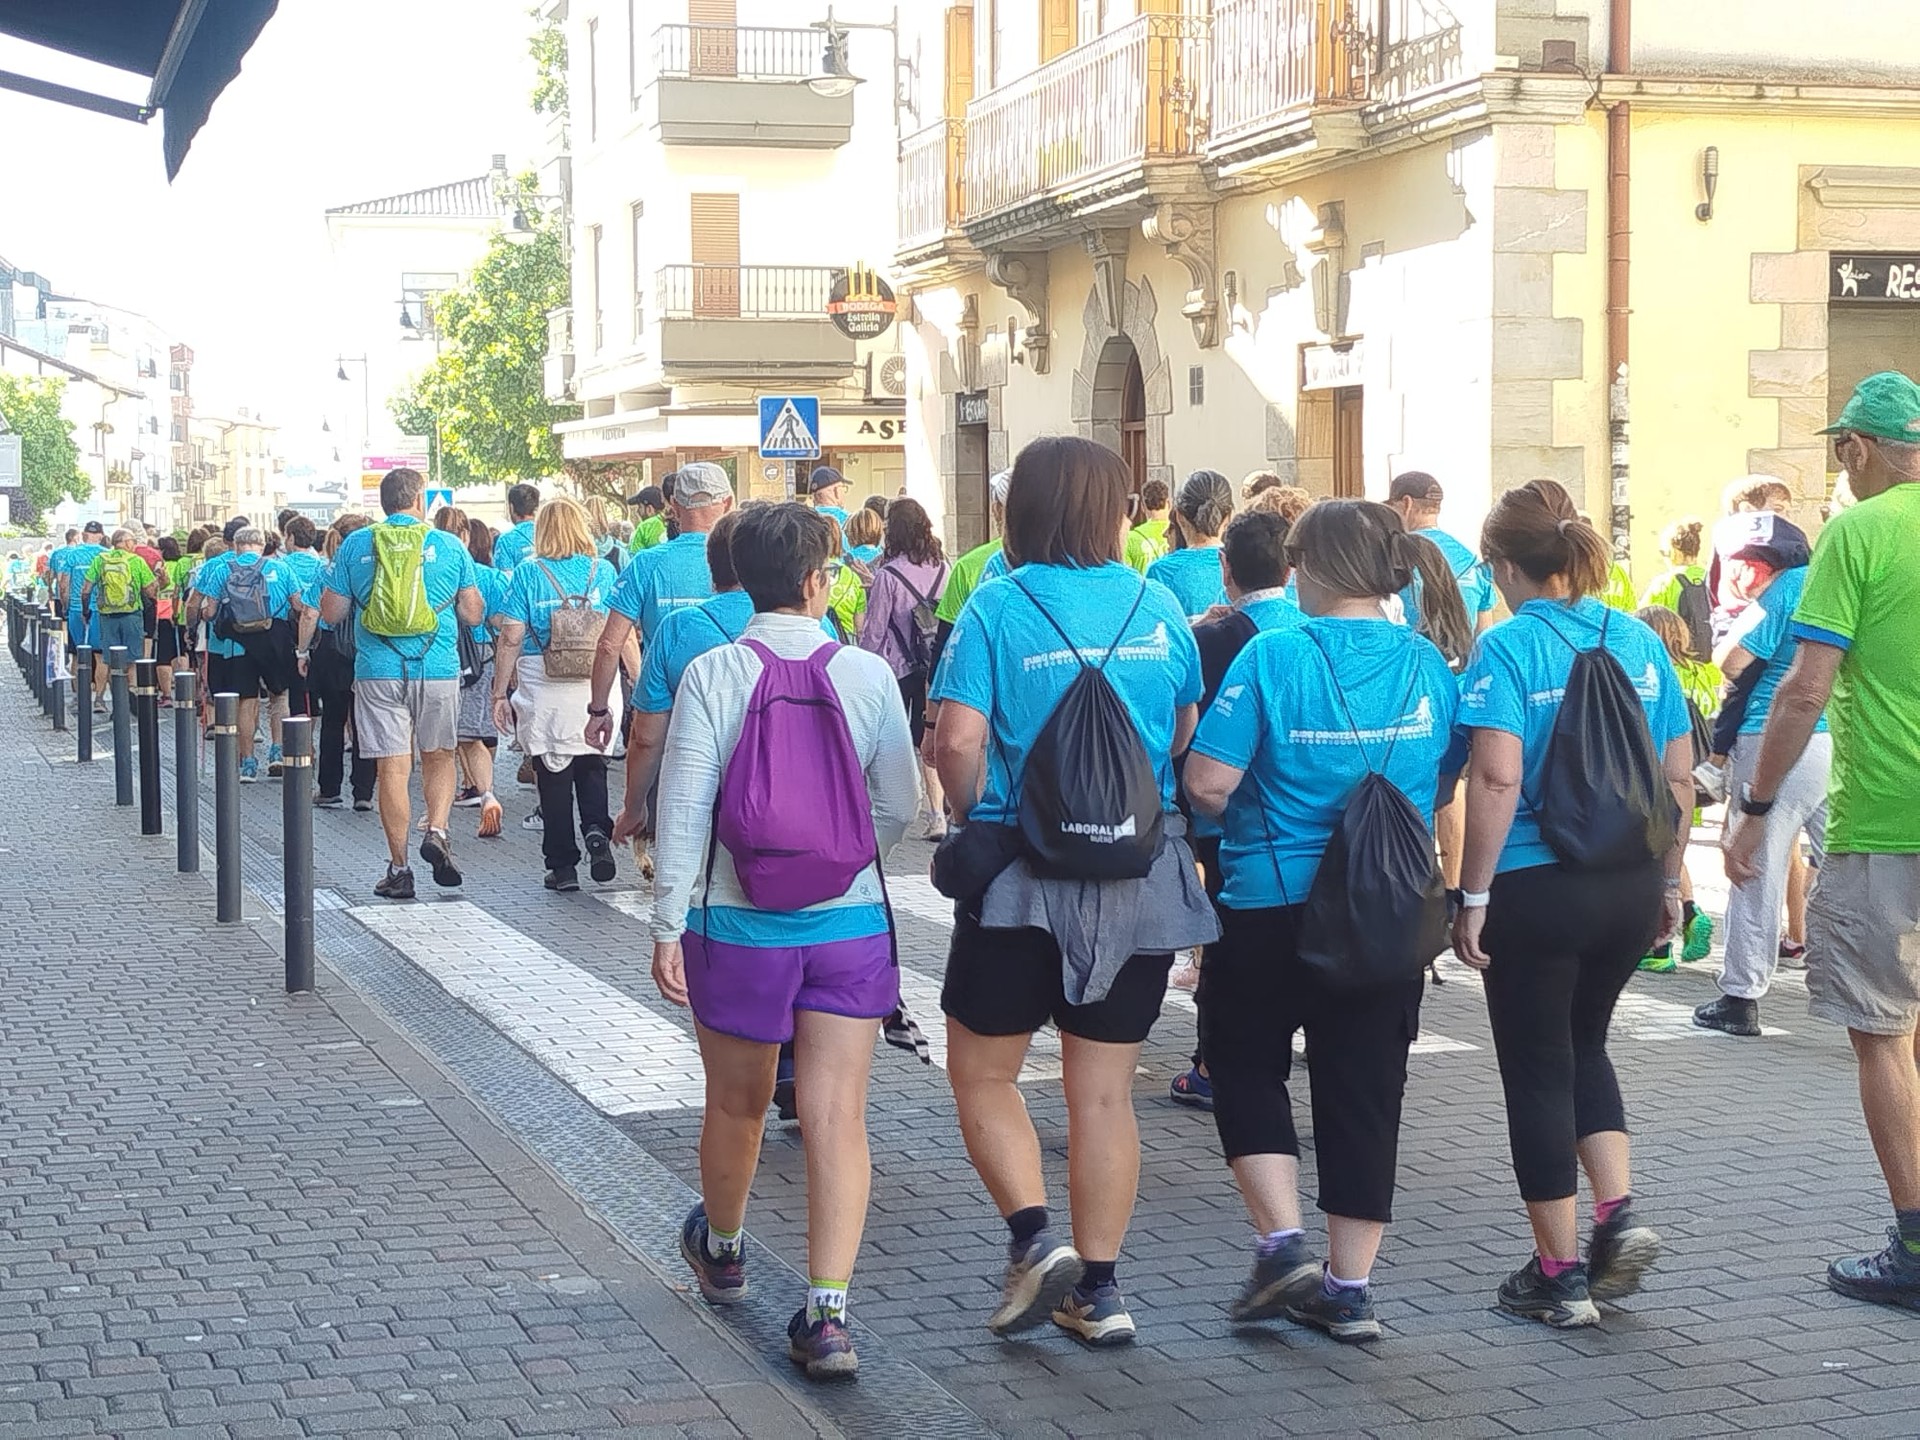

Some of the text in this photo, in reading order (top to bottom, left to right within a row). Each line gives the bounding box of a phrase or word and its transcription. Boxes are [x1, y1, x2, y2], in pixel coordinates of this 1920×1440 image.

[842, 301, 885, 312] BODEGA
[847, 312, 880, 322] Estrella
[848, 321, 879, 332] Galicia
[1061, 821, 1113, 836] LABORAL
